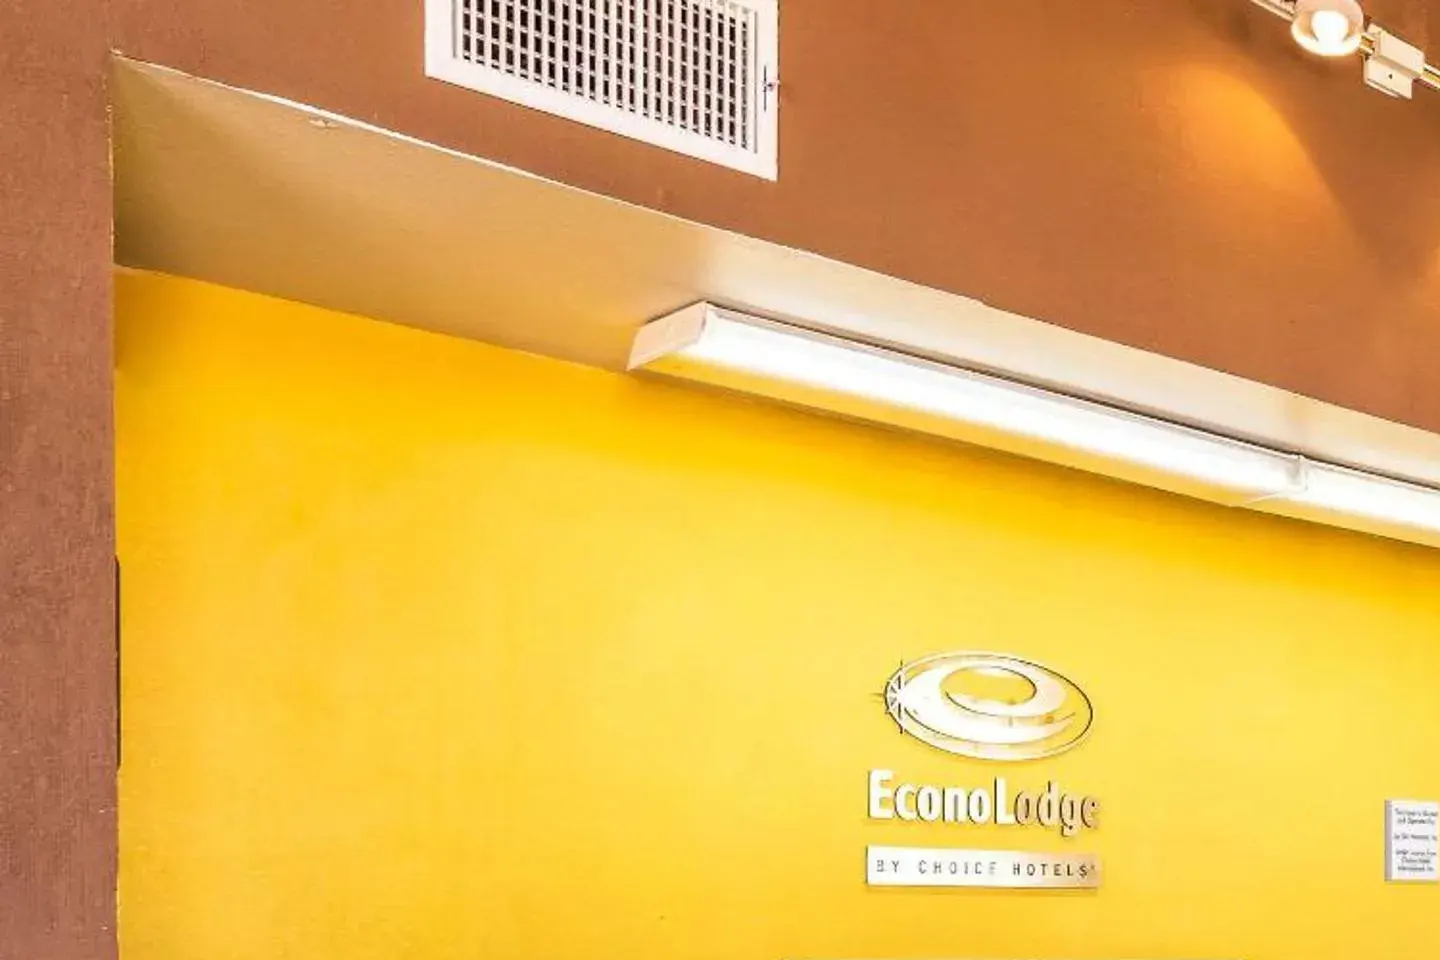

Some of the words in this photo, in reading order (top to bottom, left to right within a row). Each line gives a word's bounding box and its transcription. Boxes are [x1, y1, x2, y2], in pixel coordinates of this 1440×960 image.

[875, 859, 900, 874] BY
[917, 859, 998, 876] CHOICE
[1012, 863, 1089, 878] HOTELS
